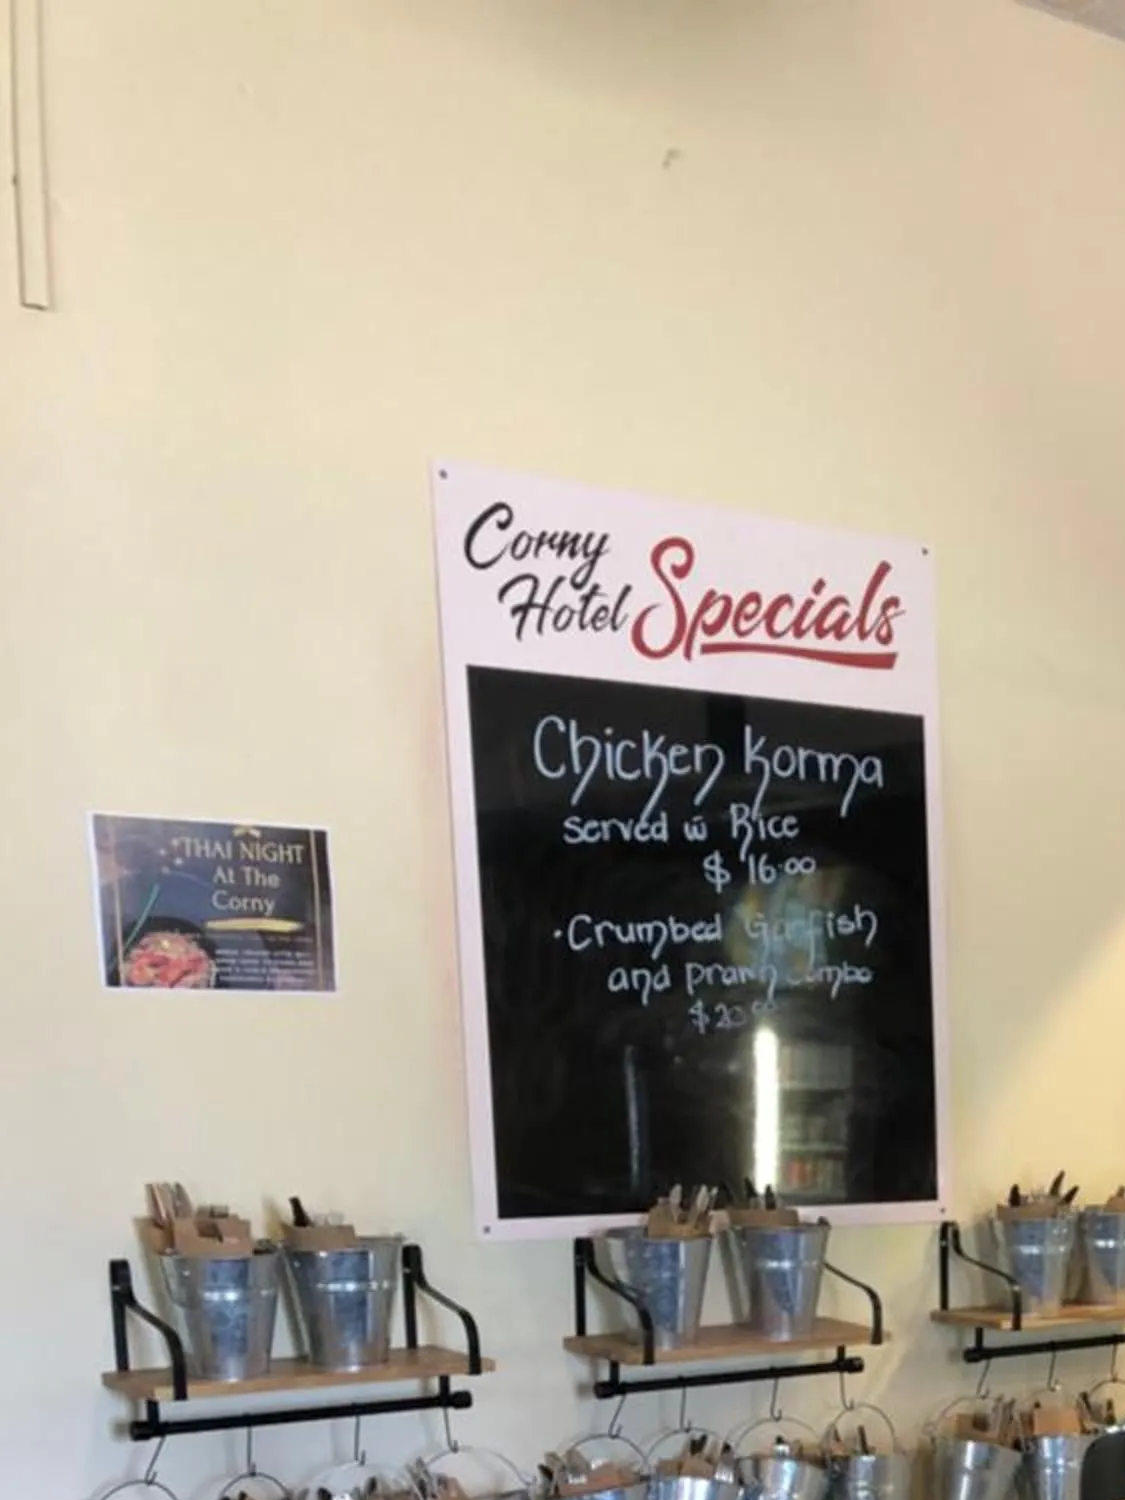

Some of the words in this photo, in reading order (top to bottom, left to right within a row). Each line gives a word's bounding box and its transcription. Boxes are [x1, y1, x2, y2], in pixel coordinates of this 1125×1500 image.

[464, 501, 611, 590] Corny
[499, 573, 632, 642] Hotel
[631, 536, 906, 662] Specials
[533, 715, 725, 822] Chicken
[183, 837, 232, 860] THAI
[240, 841, 305, 865] NIGHT
[729, 802, 800, 862] Rice
[212, 890, 276, 917] Corny
[213, 866, 237, 885] At
[244, 868, 281, 889] The
[567, 914, 722, 960] Crumbed
[608, 963, 671, 1005] and
